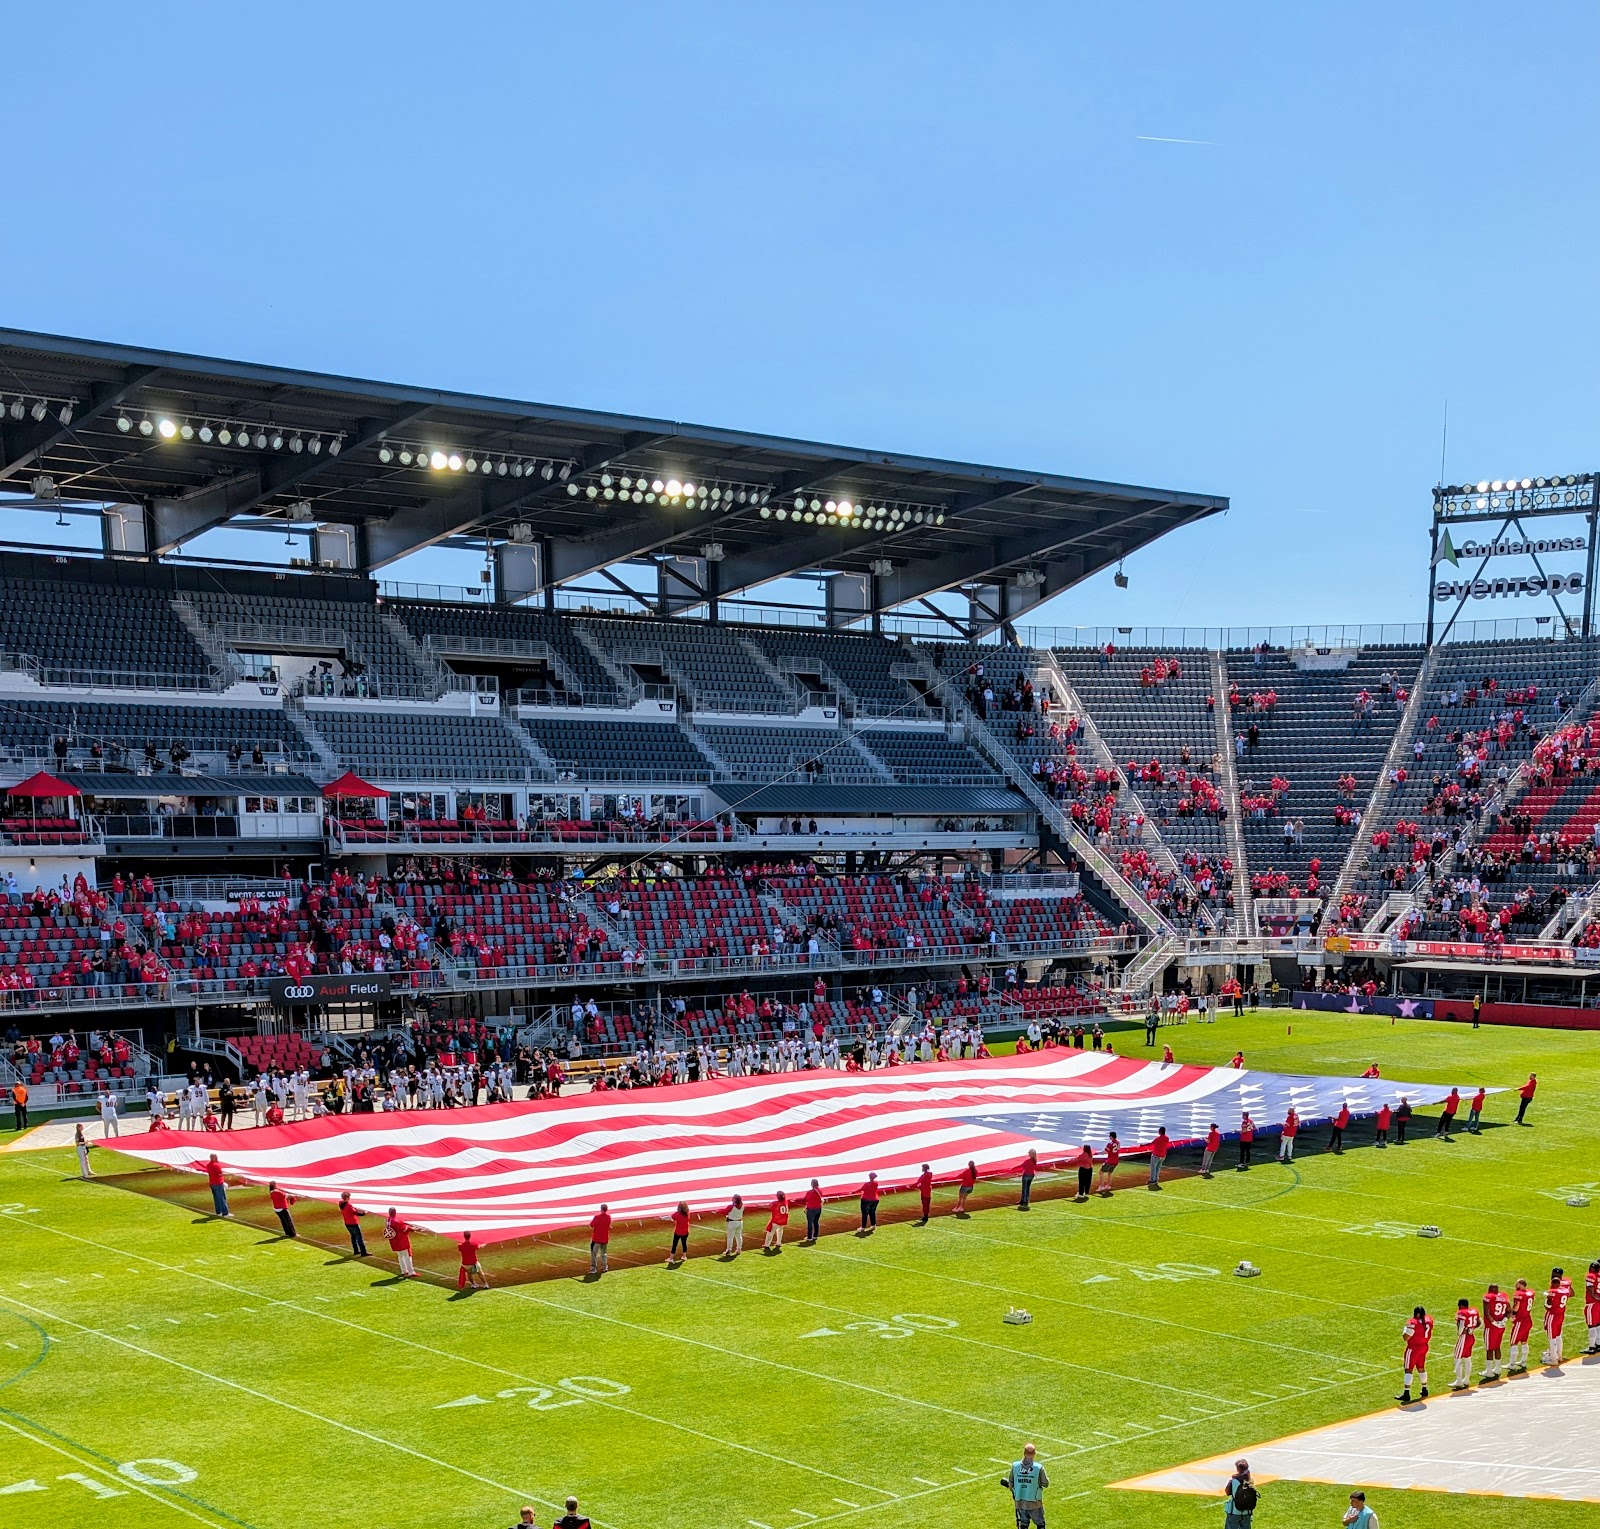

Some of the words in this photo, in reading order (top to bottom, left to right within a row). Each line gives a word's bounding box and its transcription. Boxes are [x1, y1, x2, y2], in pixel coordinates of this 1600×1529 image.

[1461, 536, 1586, 558] Guidehouse
[320, 986, 348, 995] Audi
[350, 983, 379, 995] Field
[1129, 1262, 1222, 1282] 40
[1494, 1302, 1507, 1316] 91
[844, 1313, 960, 1340] 30
[496, 1375, 632, 1412] 20
[56, 1458, 199, 1500] 10
